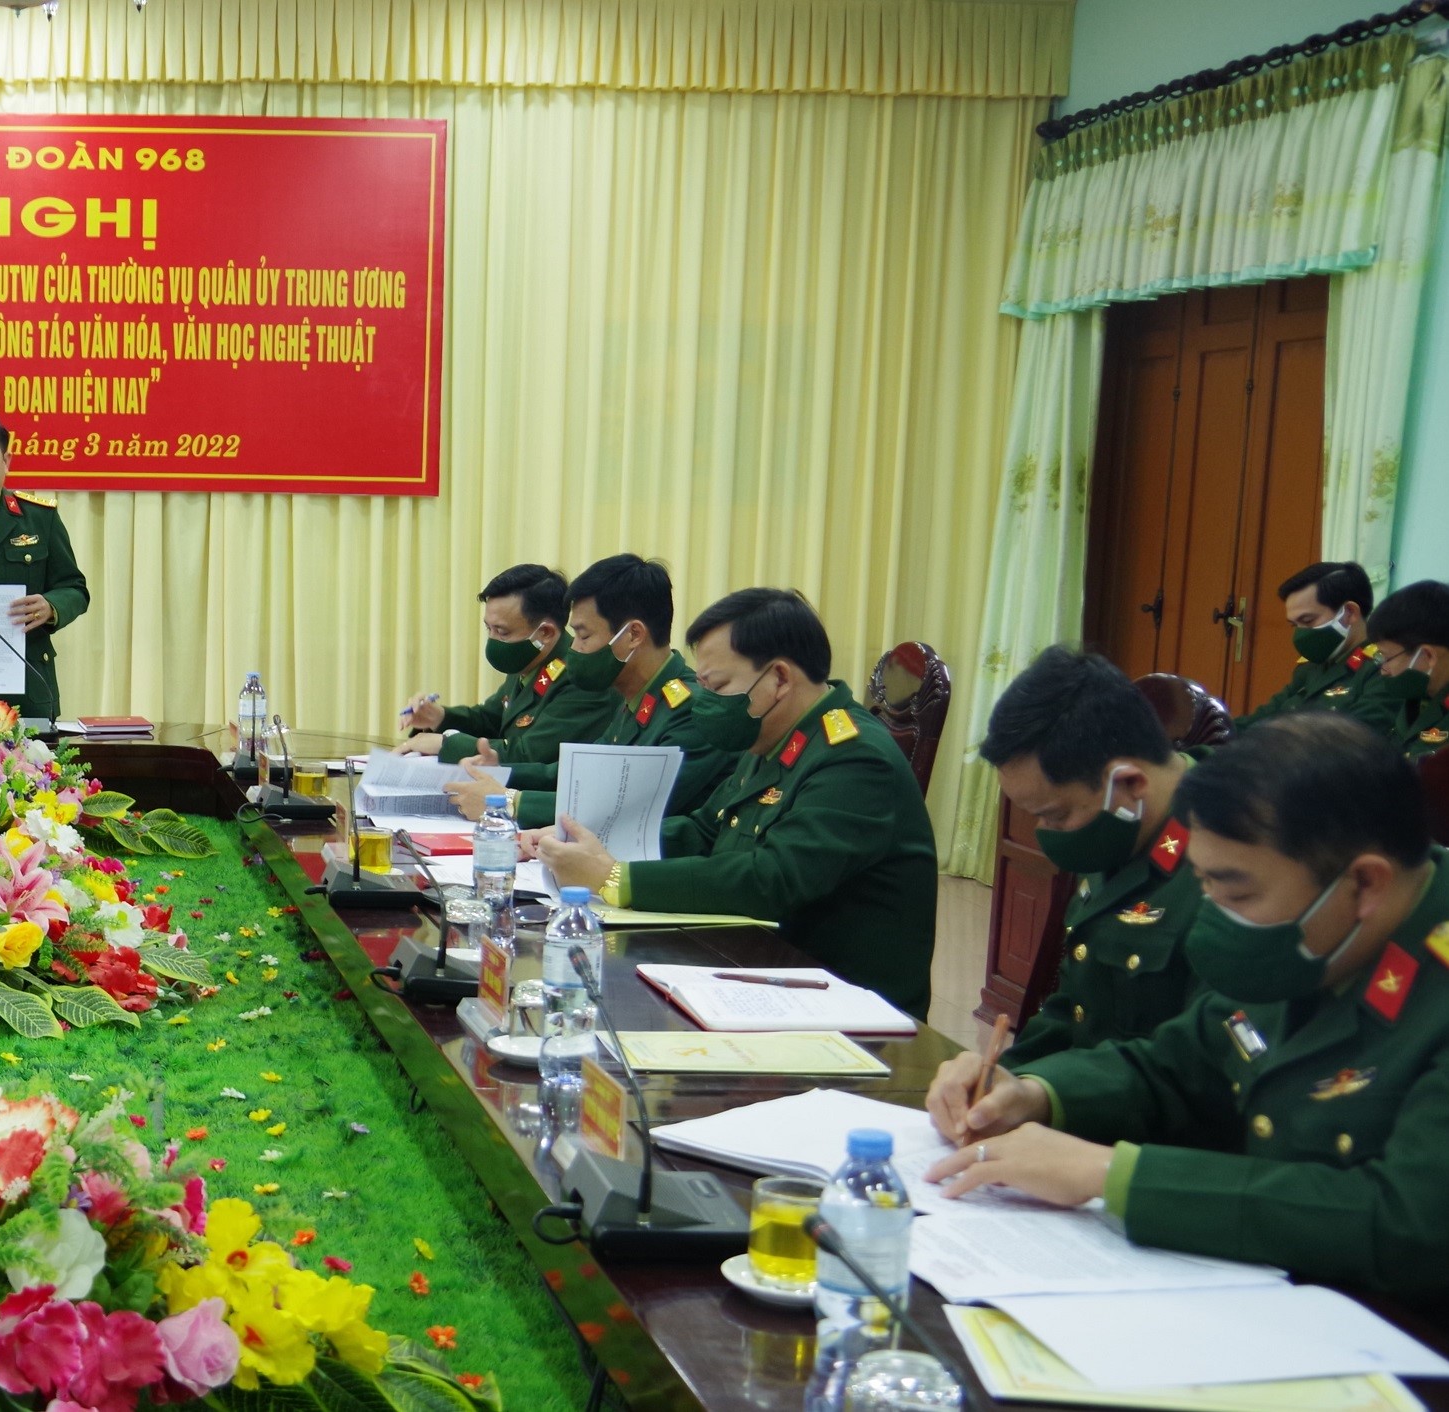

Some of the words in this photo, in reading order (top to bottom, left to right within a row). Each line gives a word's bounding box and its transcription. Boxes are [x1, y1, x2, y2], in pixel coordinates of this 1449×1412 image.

[5, 139, 124, 171] ĐOÀN
[135, 147, 206, 172] 968
[43, 252, 83, 304] CỦA
[86, 256, 165, 305] THƯỜNG
[168, 266, 194, 314] VỤ
[197, 259, 252, 309] QUÂN
[255, 255, 282, 307] ỦY
[284, 268, 349, 308] TRUNG
[352, 268, 407, 309] ƯƠNG
[37, 313, 75, 360] TÁC
[79, 313, 119, 360] VĂN
[122, 314, 168, 364] HÓA,
[172, 315, 212, 361] VĂN
[215, 322, 255, 369] HỌC
[259, 317, 312, 370] NGHỆ
[315, 318, 377, 372] THUẬT
[3, 375, 58, 422] ĐOẠN
[61, 368, 108, 423] HIỆN
[6, 430, 80, 461] háng
[83, 432, 101, 457] 3
[107, 434, 169, 457] năm
[174, 433, 241, 458] 2022
